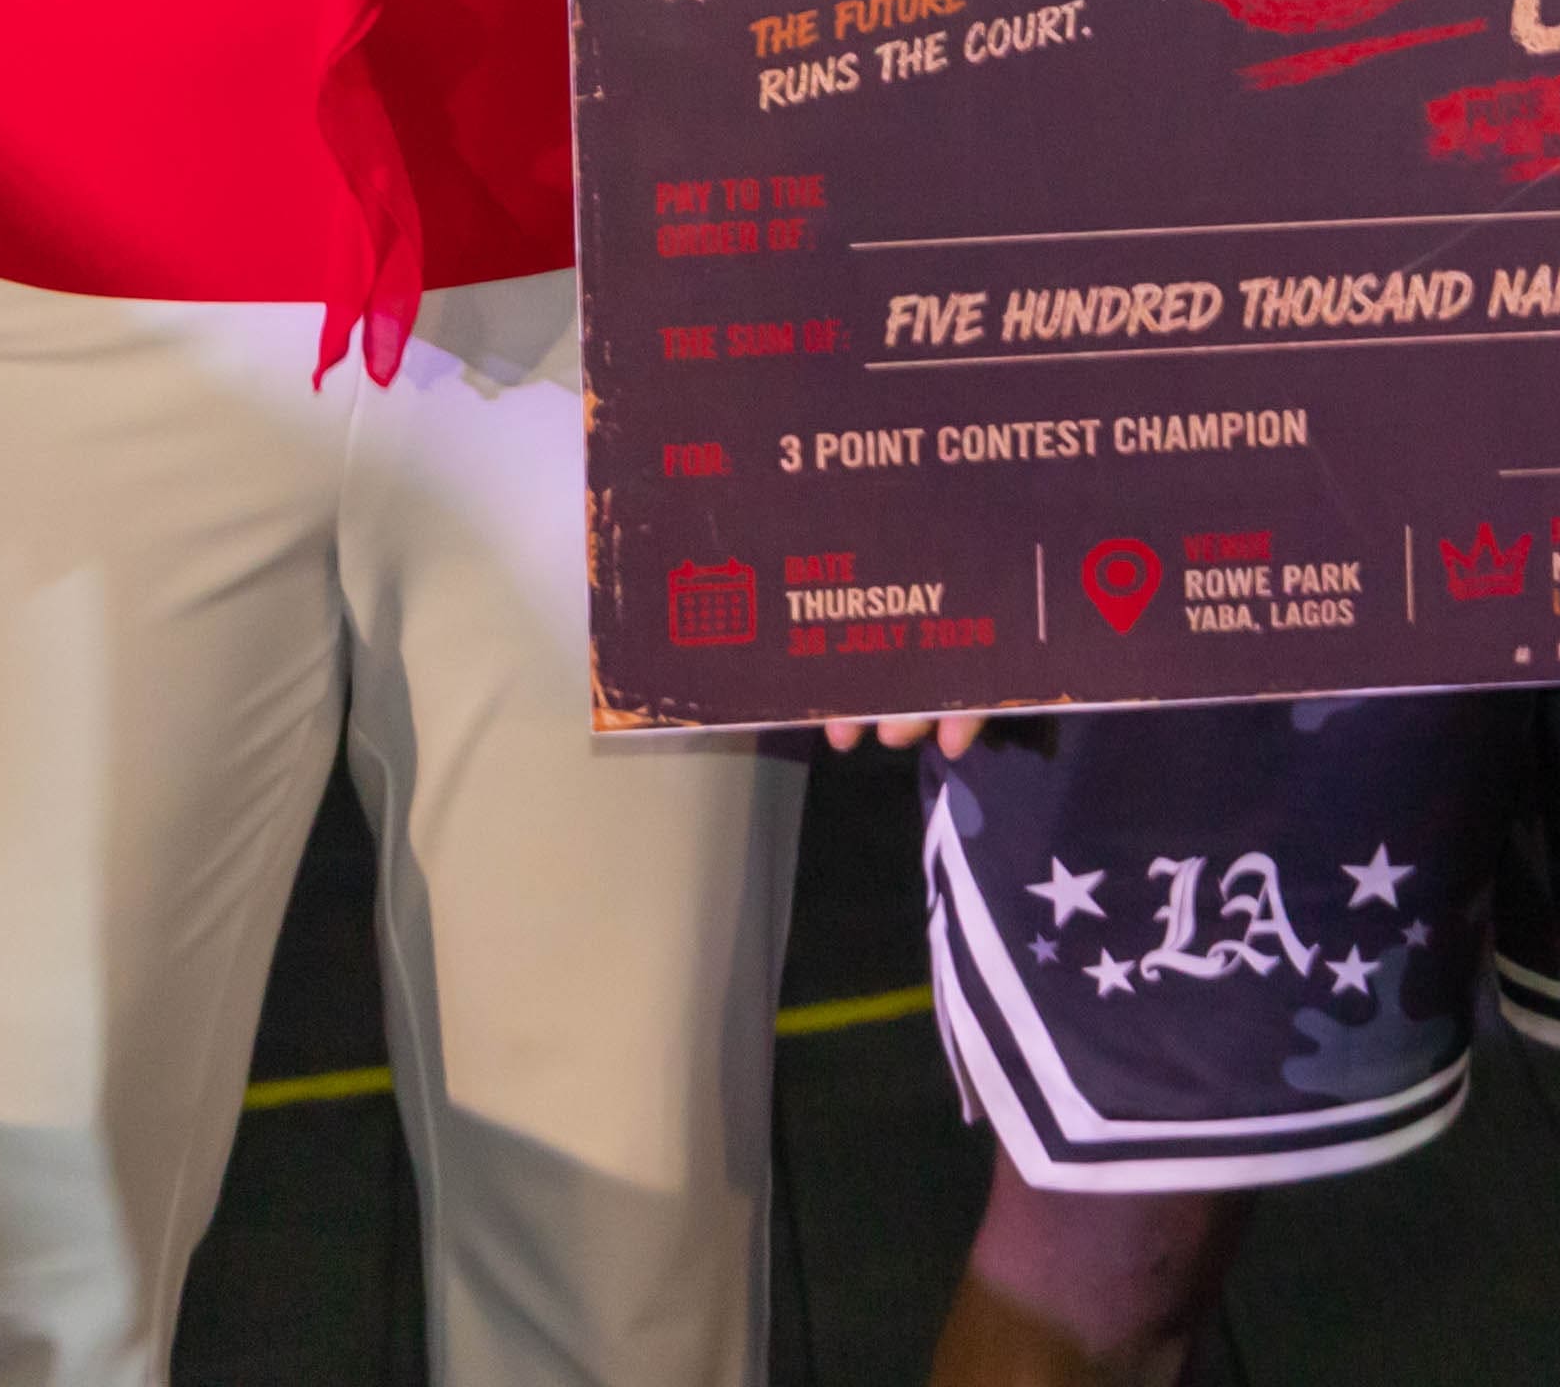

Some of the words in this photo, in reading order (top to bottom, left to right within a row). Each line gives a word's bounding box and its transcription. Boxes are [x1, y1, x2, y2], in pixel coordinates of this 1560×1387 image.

[751, 8, 816, 57] THE
[759, 52, 861, 111] RUNS
[876, 30, 949, 82] THE
[964, 0, 1092, 62] COURT.
[656, 182, 712, 214] PAY
[722, 179, 760, 211] TO
[770, 175, 826, 208] THE
[657, 221, 759, 258] ORDER
[885, 292, 989, 348] FIVE
[1002, 281, 1224, 342] HUNDRED
[1239, 270, 1473, 328] THOUSAND
[659, 326, 718, 360] THE
[727, 322, 794, 358] SUM
[779, 434, 802, 474] 3
[815, 428, 925, 471] POINT
[938, 418, 1100, 464] CONTEST
[1114, 408, 1307, 455] CHAMPION
[784, 552, 856, 584] DATE
[1184, 565, 1273, 601] ROWE
[1282, 561, 1363, 595] PARK
[786, 582, 944, 623] THURSDAY
[1185, 603, 1262, 635] YABA,
[1270, 598, 1356, 630] LAGOS
[1141, 851, 1320, 981] LA
